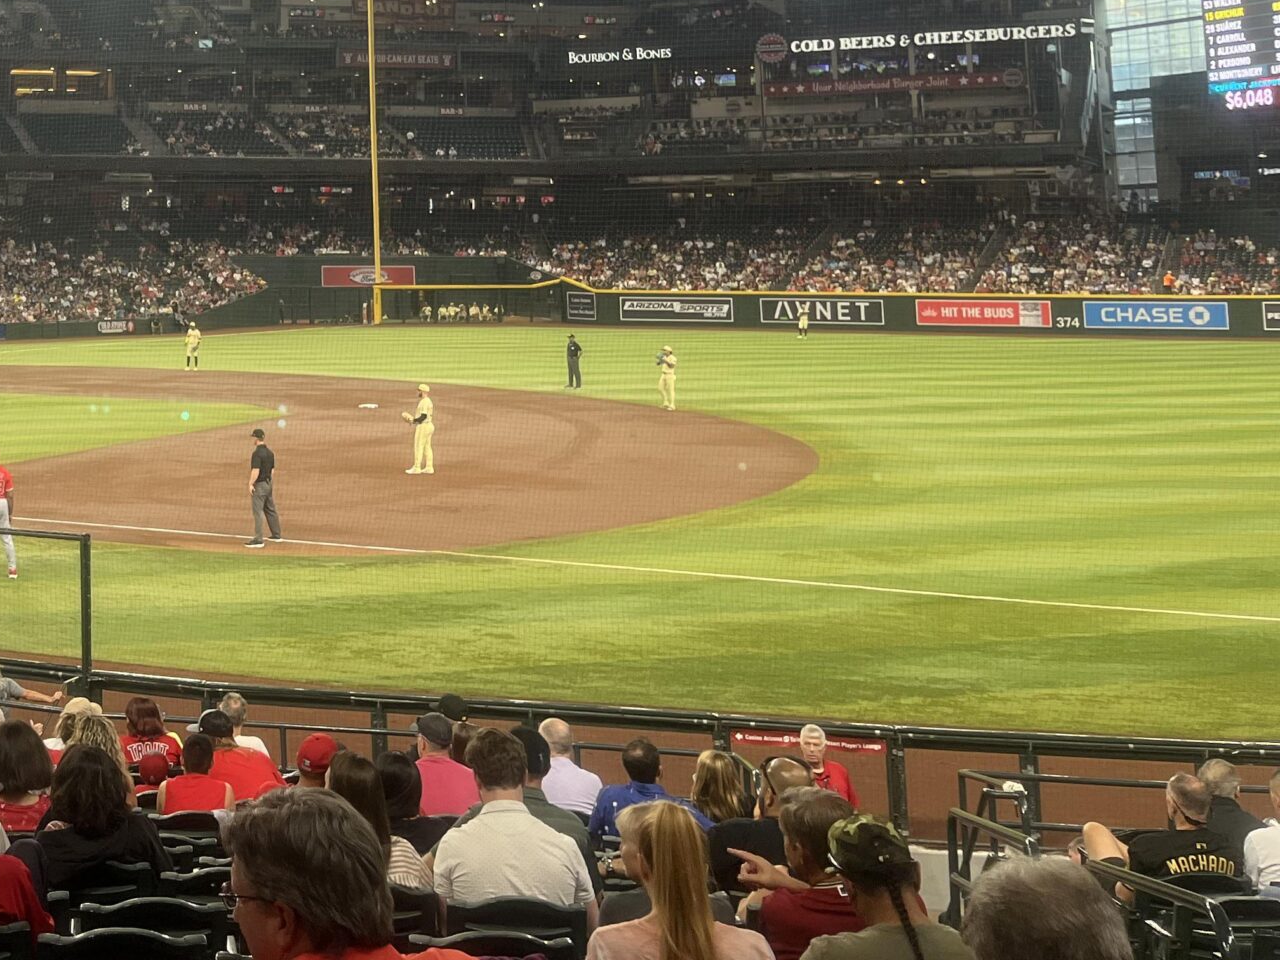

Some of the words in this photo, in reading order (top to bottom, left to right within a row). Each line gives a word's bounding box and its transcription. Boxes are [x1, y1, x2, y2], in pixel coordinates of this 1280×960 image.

[790, 39, 835, 53] COLD
[839, 34, 896, 50] BEERS
[899, 34, 910, 47] &
[914, 23, 1077, 46] CHEESEBURGERS
[1216, 32, 1247, 44] CARROLL
[568, 51, 620, 64] BOURBON
[622, 48, 633, 61] &
[635, 47, 672, 60] BONES
[1217, 43, 1256, 56] ALEXANDER
[421, 55, 439, 64] SEATS
[892, 77, 923, 91] Burger
[926, 76, 948, 87] Joint
[1225, 88, 1274, 110] $6,048
[627, 302, 675, 310] ARIZONA
[679, 304, 725, 312] SPORTS
[774, 301, 870, 321] AVNET
[940, 307, 957, 318] HIT
[961, 307, 981, 318] THE
[984, 307, 1014, 318] BUDS
[1056, 317, 1080, 328] 374
[1101, 307, 1184, 323] CHASE
[1166, 854, 1235, 876] MACHADO
